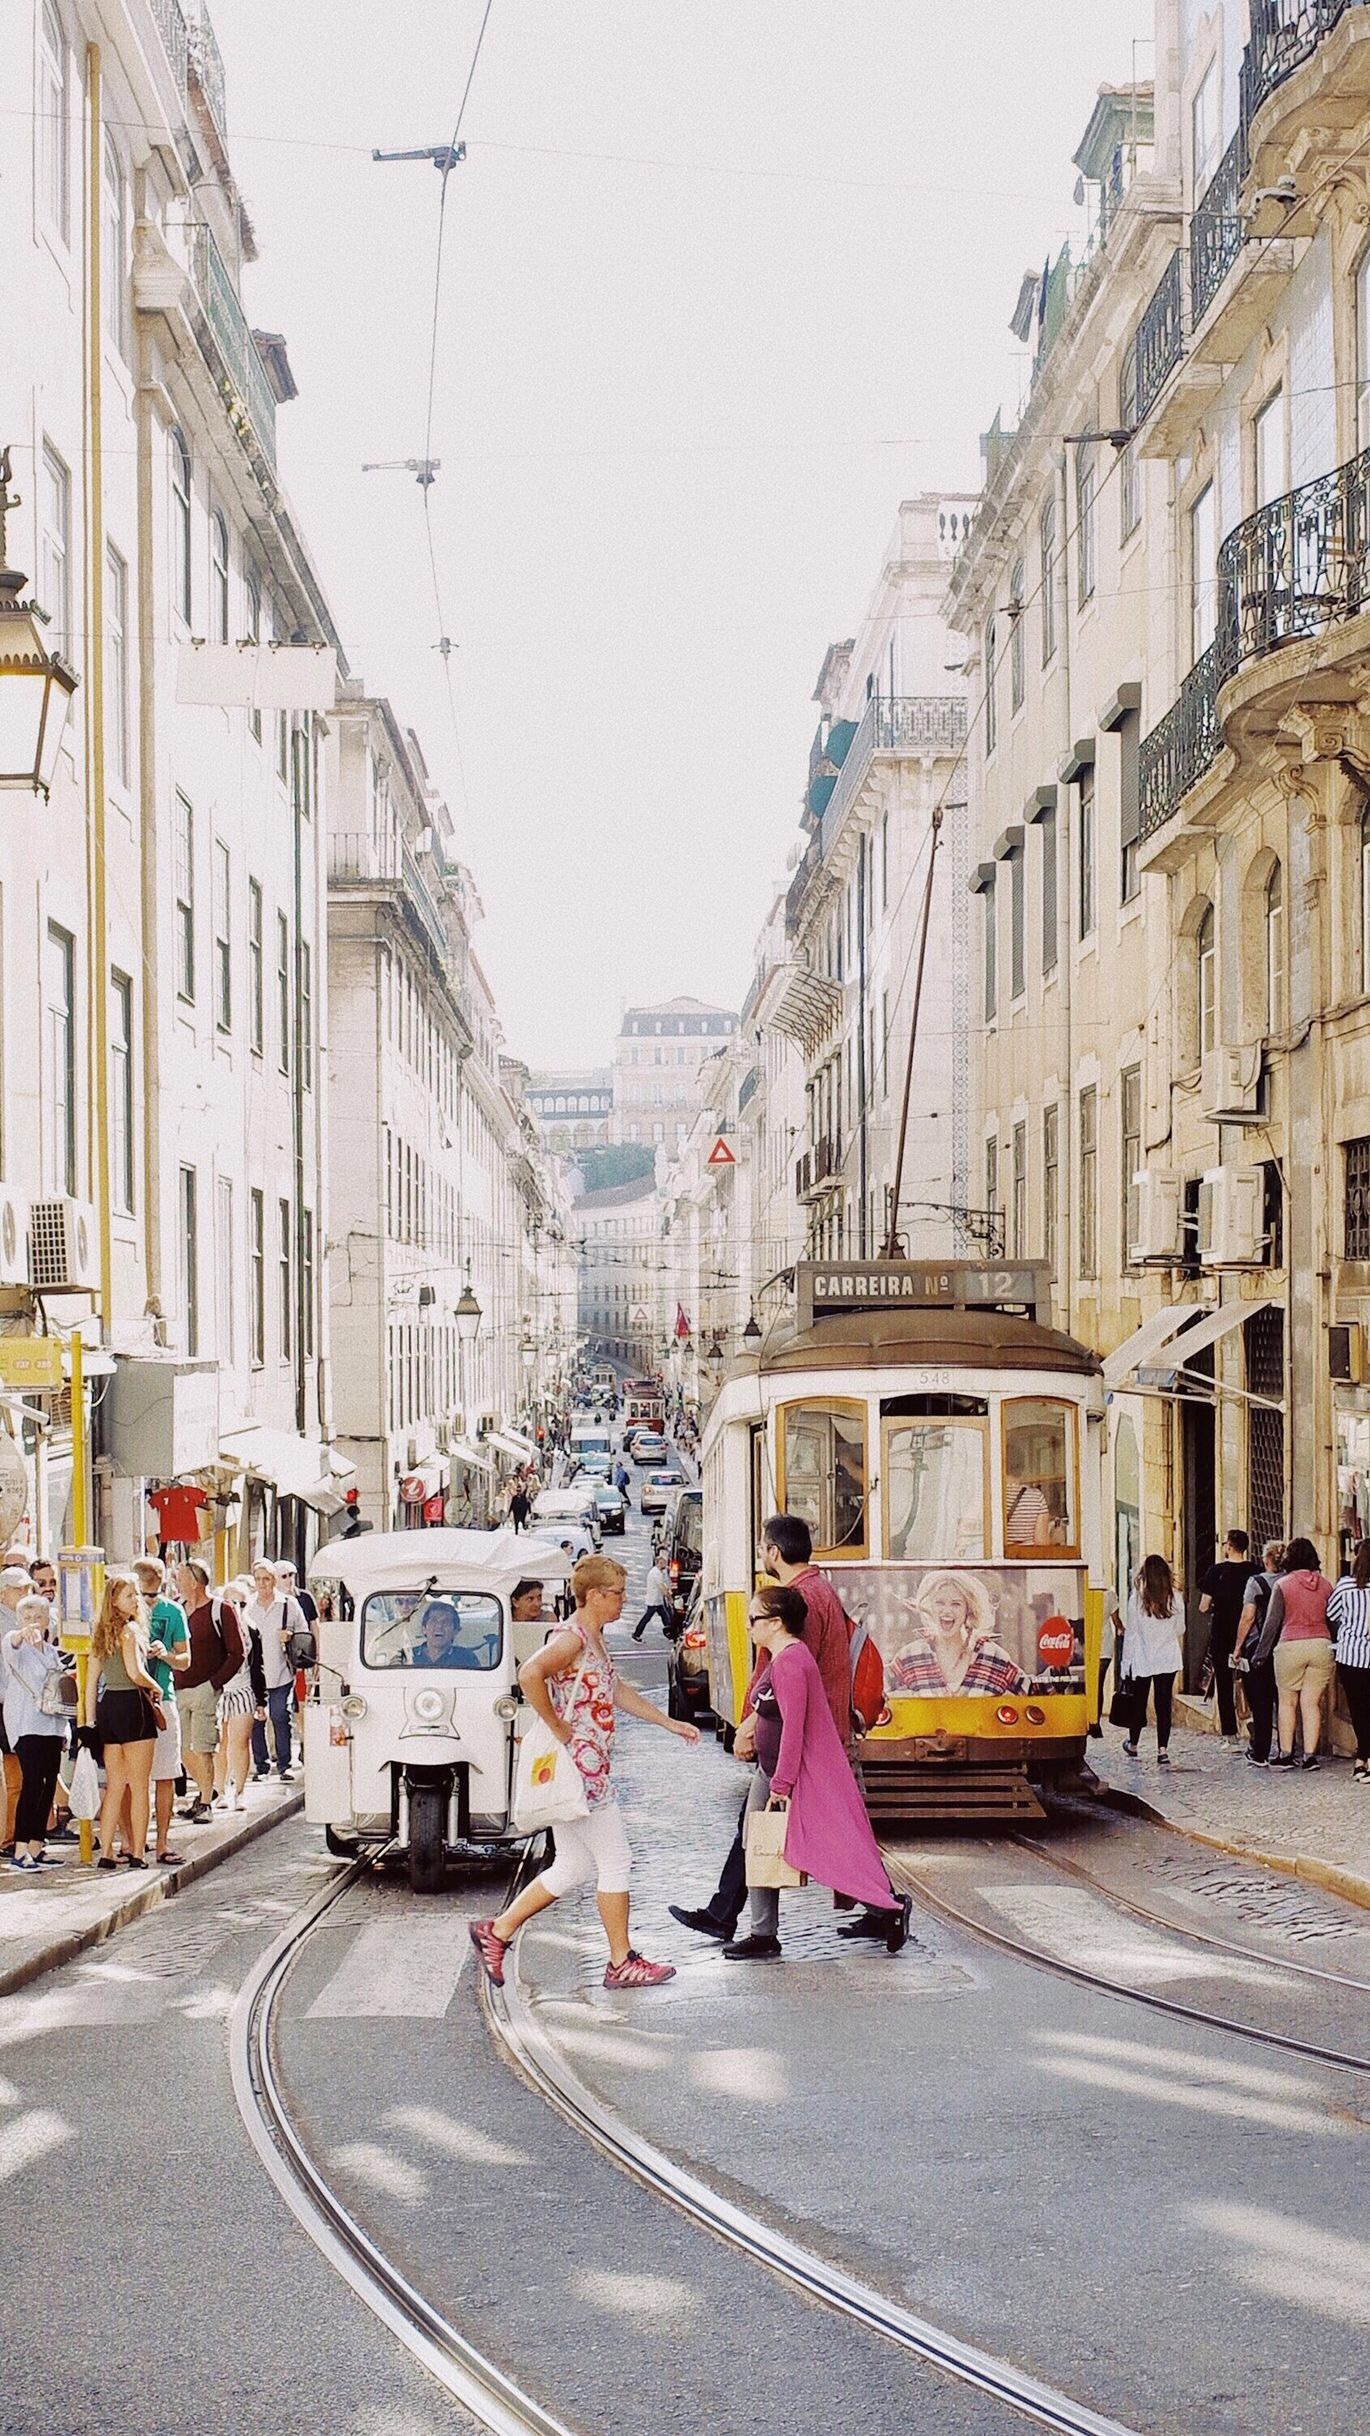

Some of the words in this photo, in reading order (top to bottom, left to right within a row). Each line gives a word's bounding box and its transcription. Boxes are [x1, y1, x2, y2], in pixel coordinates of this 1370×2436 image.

[814, 1275, 913, 1297] CARREIRA
[925, 1276, 949, 1296] Nº
[979, 1271, 1013, 1298] 12
[919, 1371, 950, 1385] 548
